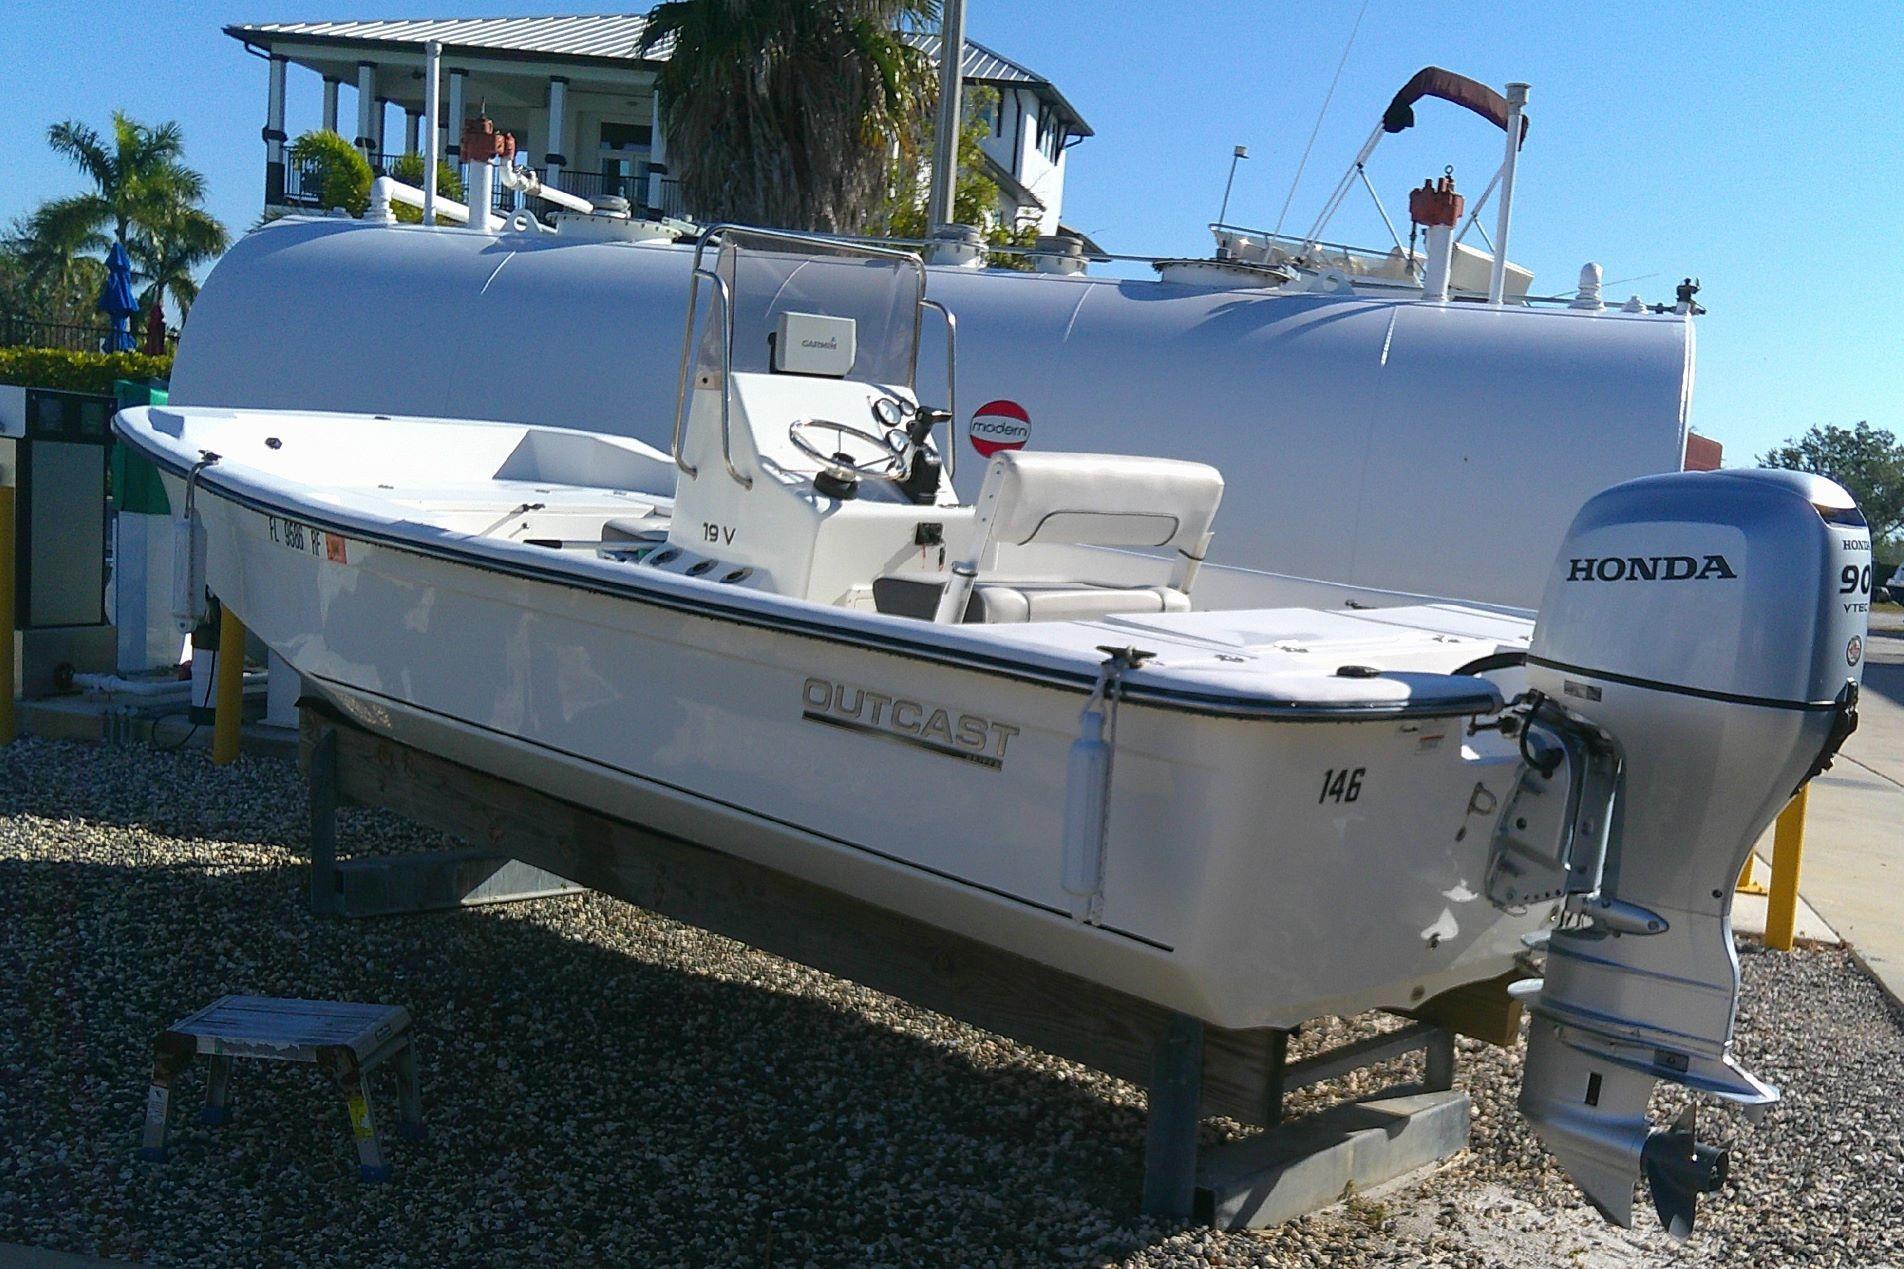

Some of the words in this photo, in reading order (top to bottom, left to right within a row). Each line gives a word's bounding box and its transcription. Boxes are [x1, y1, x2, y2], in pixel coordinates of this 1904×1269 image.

[801, 338, 837, 350] GARMIN
[972, 421, 1028, 437] modern
[269, 515, 280, 542] FL
[703, 522, 719, 542] 19
[723, 526, 736, 546] V
[1566, 554, 1738, 582] HONDA
[1839, 564, 1872, 595] 90
[802, 677, 1020, 758] OUTCAST
[1318, 767, 1366, 804] 146
